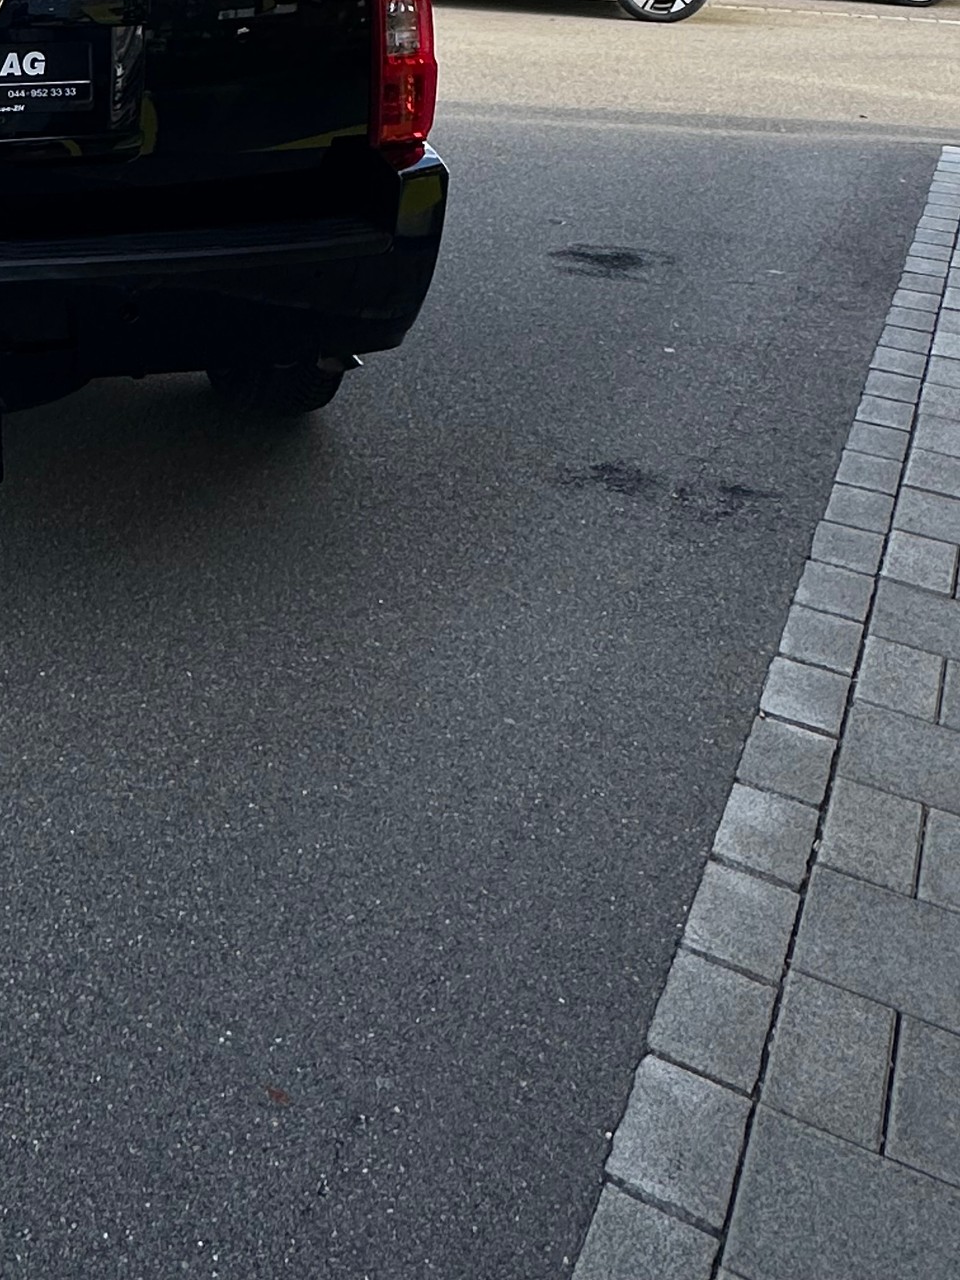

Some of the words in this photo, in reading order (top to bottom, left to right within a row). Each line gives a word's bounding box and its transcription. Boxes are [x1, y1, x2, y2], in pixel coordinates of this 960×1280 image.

[0, 51, 46, 77] AG
[50, 87, 62, 97] 33
[65, 87, 77, 96] 33
